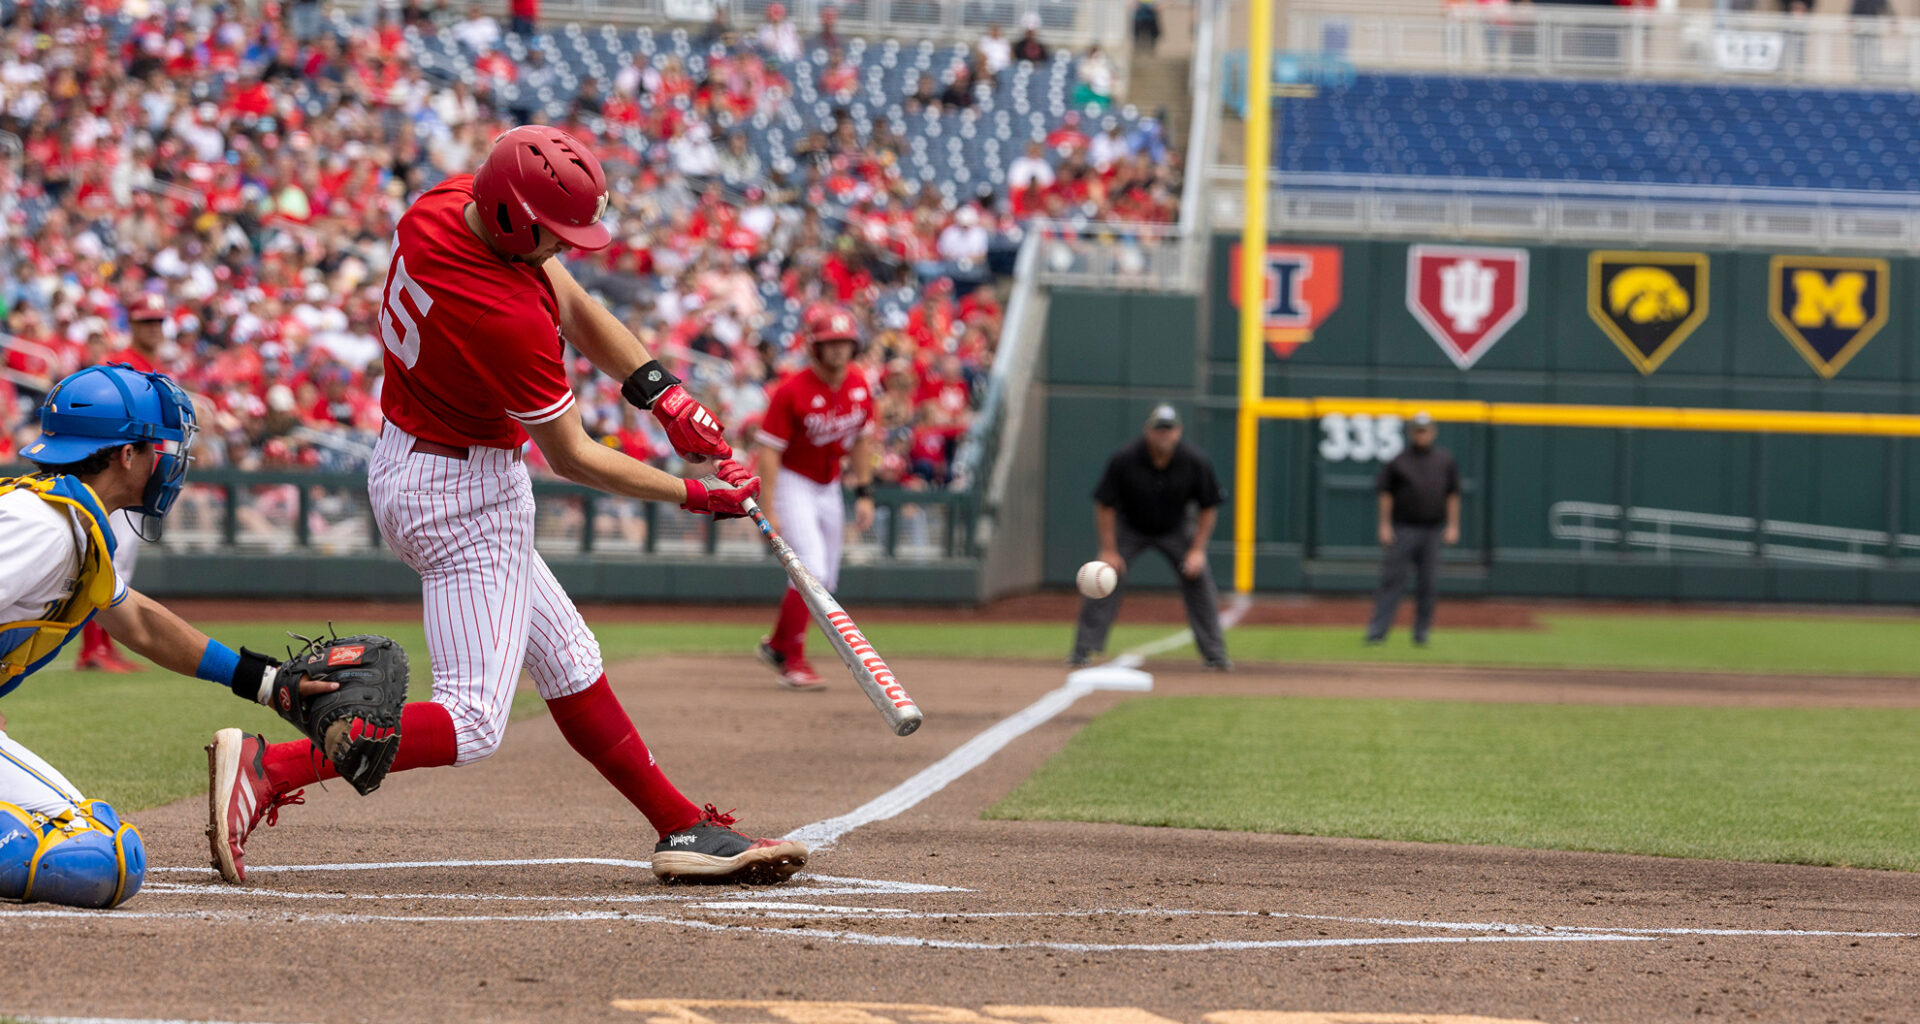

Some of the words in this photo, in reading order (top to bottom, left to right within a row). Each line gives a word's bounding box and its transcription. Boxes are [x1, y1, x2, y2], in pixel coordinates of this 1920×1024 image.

[1791, 269, 1868, 329] M
[1318, 412, 1405, 463] 335
[826, 610, 917, 709] marucci
